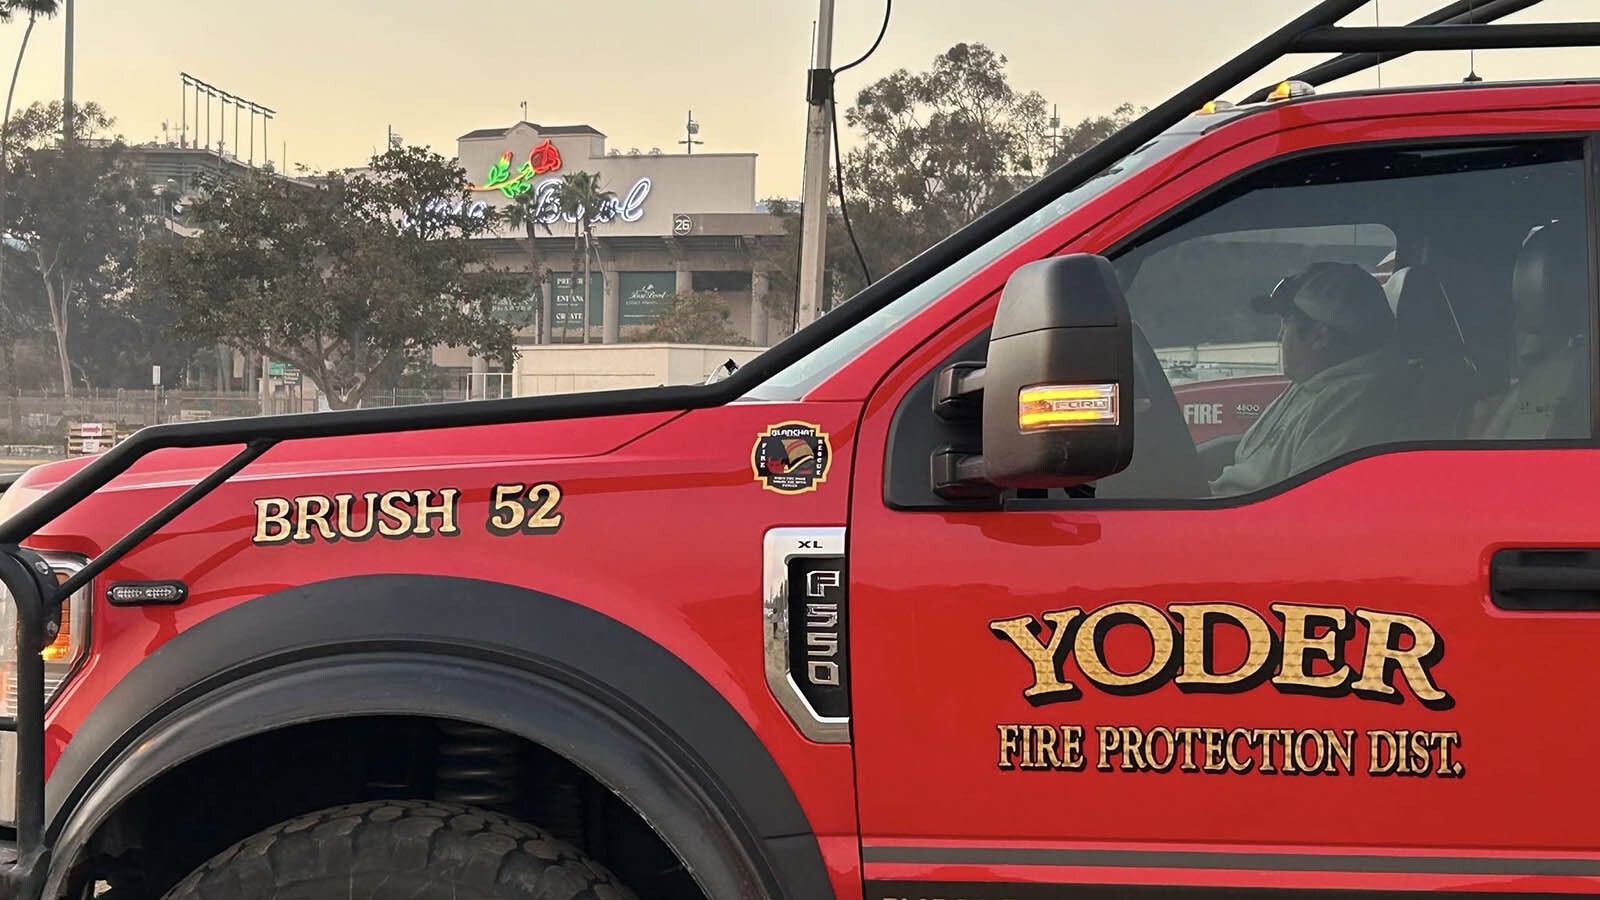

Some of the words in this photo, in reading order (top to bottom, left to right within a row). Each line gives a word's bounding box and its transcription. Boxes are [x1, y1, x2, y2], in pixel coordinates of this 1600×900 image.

[675, 219, 690, 231] 26
[1055, 400, 1107, 409] FORD
[1183, 403, 1223, 425] FIRE
[771, 429, 815, 437] BLANCHAT
[252, 488, 461, 545] BRUSH
[485, 482, 564, 536] 52
[798, 540, 823, 549] XL
[806, 570, 841, 687] F550
[989, 601, 1455, 709] YODER
[996, 724, 1086, 772] FIRE
[1095, 725, 1354, 775] PROTECTION
[1366, 729, 1465, 778] DIST.
